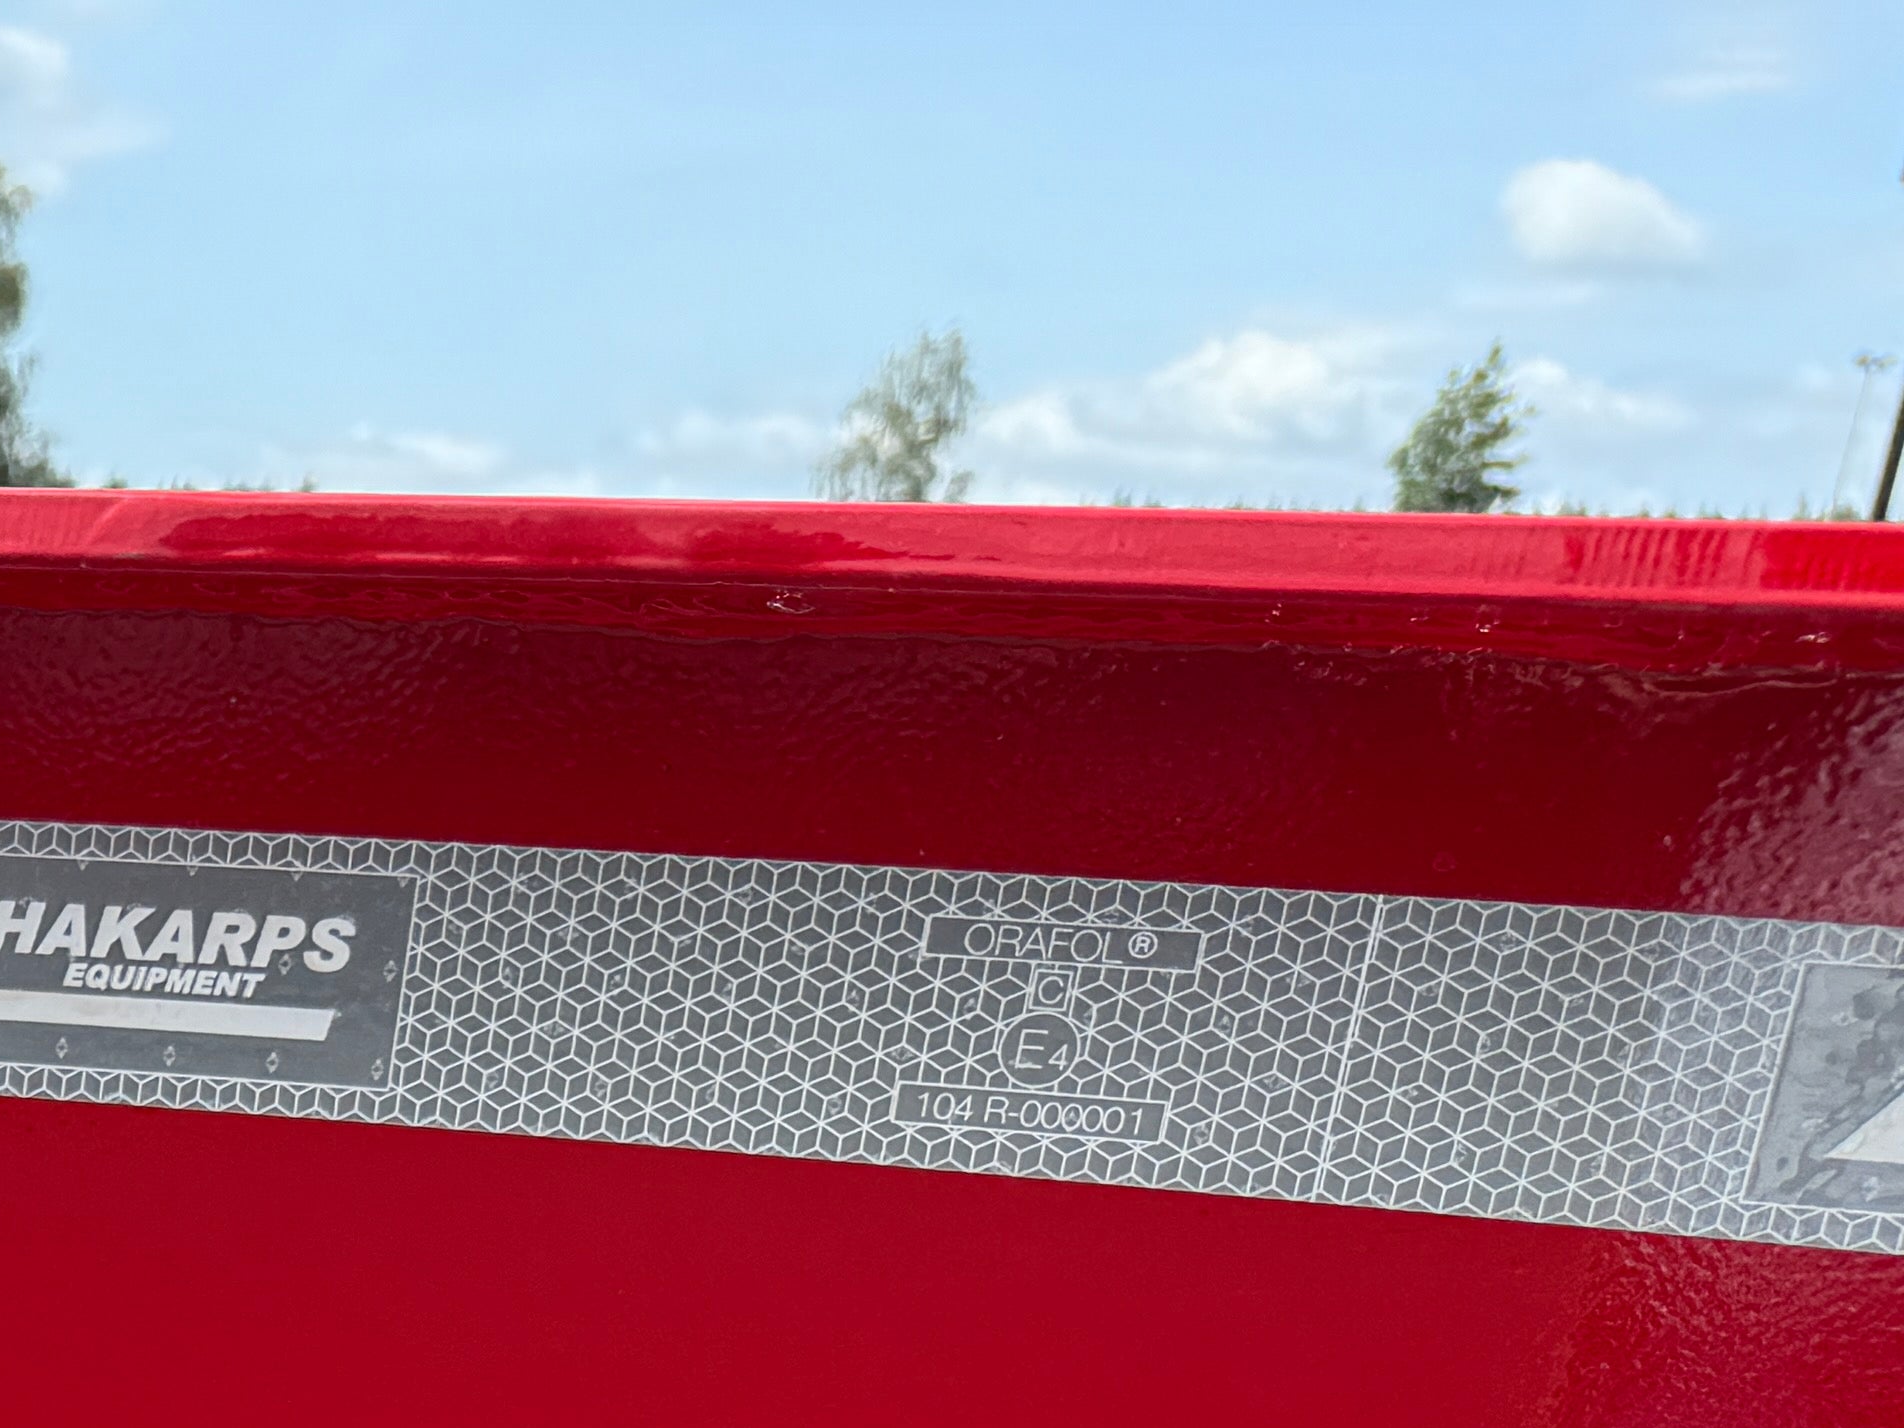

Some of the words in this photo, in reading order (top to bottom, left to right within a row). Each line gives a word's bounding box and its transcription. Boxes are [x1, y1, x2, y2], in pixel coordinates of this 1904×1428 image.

[62, 962, 267, 999] EQUIPMENT
[1037, 975, 1065, 1004] C
[917, 1091, 974, 1121] 104
[983, 1095, 1145, 1137] R-000001
